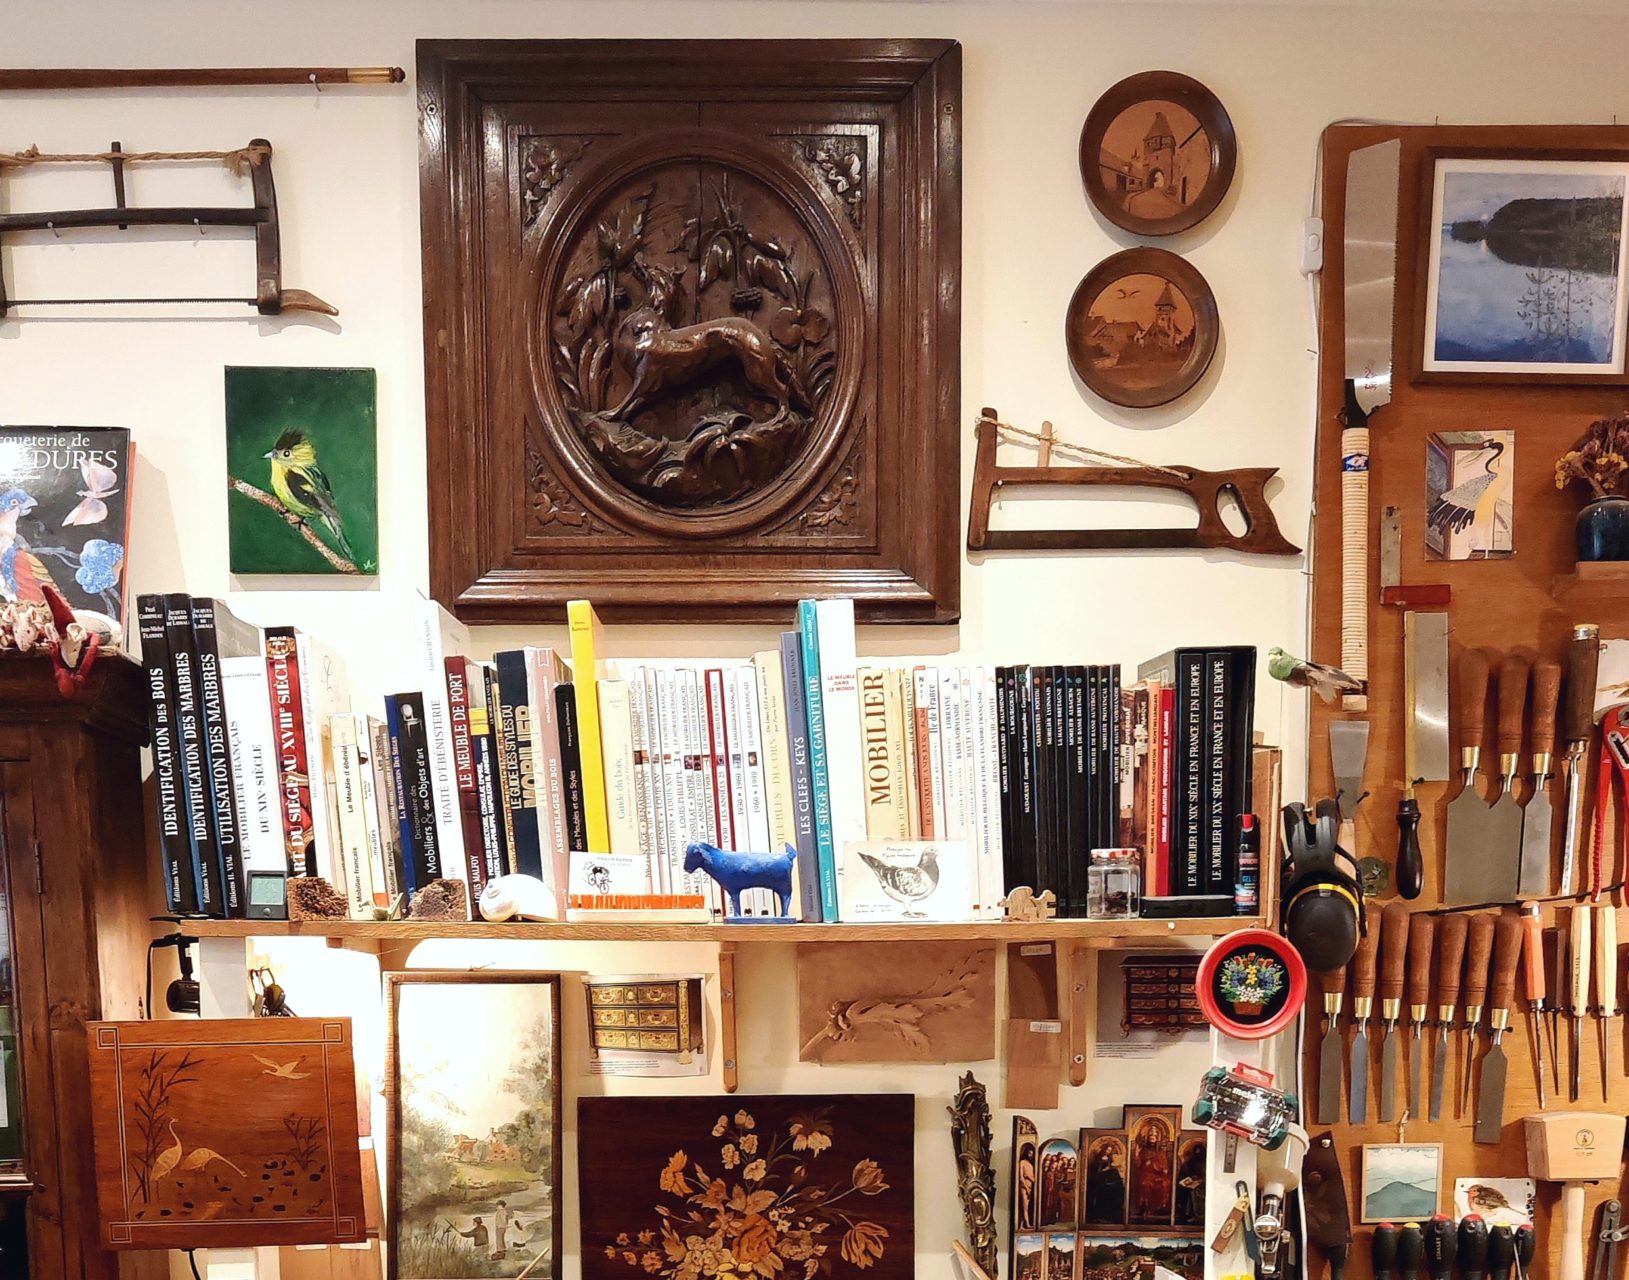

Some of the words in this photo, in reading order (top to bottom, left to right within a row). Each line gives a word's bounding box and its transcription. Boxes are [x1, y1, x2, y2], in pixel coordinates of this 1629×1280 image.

[72, 433, 90, 447] de
[31, 449, 118, 470] DURES
[150, 668, 165, 699] BOIS
[175, 652, 194, 711] MARBRES
[201, 654, 221, 722] MARBRES
[273, 652, 291, 704] SIÈCLE
[448, 672, 464, 702] PORT
[1190, 664, 1200, 696] EUROPE
[1213, 660, 1224, 693] EUROPE
[927, 684, 937, 710] France
[1190, 699, 1199, 710] EN
[1213, 695, 1223, 707] EN
[157, 704, 167, 722] DES
[452, 705, 466, 721] DE
[501, 705, 513, 718] DU
[808, 675, 824, 749] GARNITURE
[928, 712, 937, 721] de
[944, 695, 952, 729] LORRAINE
[1190, 713, 1199, 723] ET
[1213, 710, 1223, 720] ET
[182, 715, 197, 739] DES
[209, 726, 225, 753] DES
[503, 719, 516, 751] STYLES
[862, 672, 891, 806] MOBILIER
[1213, 722, 1223, 754] FRANCE
[229, 721, 243, 779] FRANÇAIS
[431, 700, 448, 782] D'ÉBÉNISTERIE
[454, 724, 471, 770] MEUBLE
[794, 736, 806, 766] KEYS
[1189, 725, 1199, 757] FRANCE
[252, 744, 265, 785] SIÈCLE
[283, 754, 297, 773] AU
[416, 748, 425, 766] d'art
[507, 752, 518, 769] DES
[515, 705, 545, 808] MOBILIER
[549, 758, 557, 777] BOIS
[814, 753, 825, 768] SA
[1190, 760, 1199, 771] EN
[1213, 757, 1222, 768] EN
[156, 727, 178, 836] IDENTIFICATION
[184, 742, 208, 840] IDENTIFICATION
[418, 768, 431, 798] Objets
[460, 773, 473, 789] LE
[509, 770, 520, 797] GUIDE
[551, 779, 559, 791] DU
[569, 771, 579, 789] Styles
[815, 770, 826, 786] ET
[1187, 774, 1199, 802] SIÈCLE
[1210, 770, 1222, 798] SIÈCLE
[212, 758, 235, 844] UTILISATION
[437, 786, 453, 825] TRAITÉ
[512, 798, 522, 809] LE
[719, 781, 727, 808] ANNÉES
[797, 777, 809, 812] CLEFS
[815, 790, 829, 825] SIÈGE
[235, 783, 249, 840] MOBILIER
[260, 817, 269, 832] DU
[399, 811, 406, 819] LA
[412, 798, 422, 839] Dictionnaire
[420, 813, 435, 825] &
[552, 793, 564, 853] ASSEMBLAGES
[572, 811, 581, 837] Meubles
[706, 793, 714, 831] NOUVEAU
[1213, 816, 1222, 827] DU
[290, 825, 304, 847] DU
[800, 816, 811, 835] LES
[820, 830, 831, 847] LE
[1189, 821, 1198, 833] DU
[243, 845, 251, 860] LE
[424, 827, 437, 873] Mobiliers
[670, 820, 678, 867] TRANSITION
[1188, 836, 1198, 873] MOBILIER
[1212, 829, 1222, 867] MOBILIER
[470, 855, 480, 882] MALFOY
[1188, 876, 1197, 886] LE
[1212, 869, 1221, 880] LE
[473, 884, 481, 903] LOUIS
